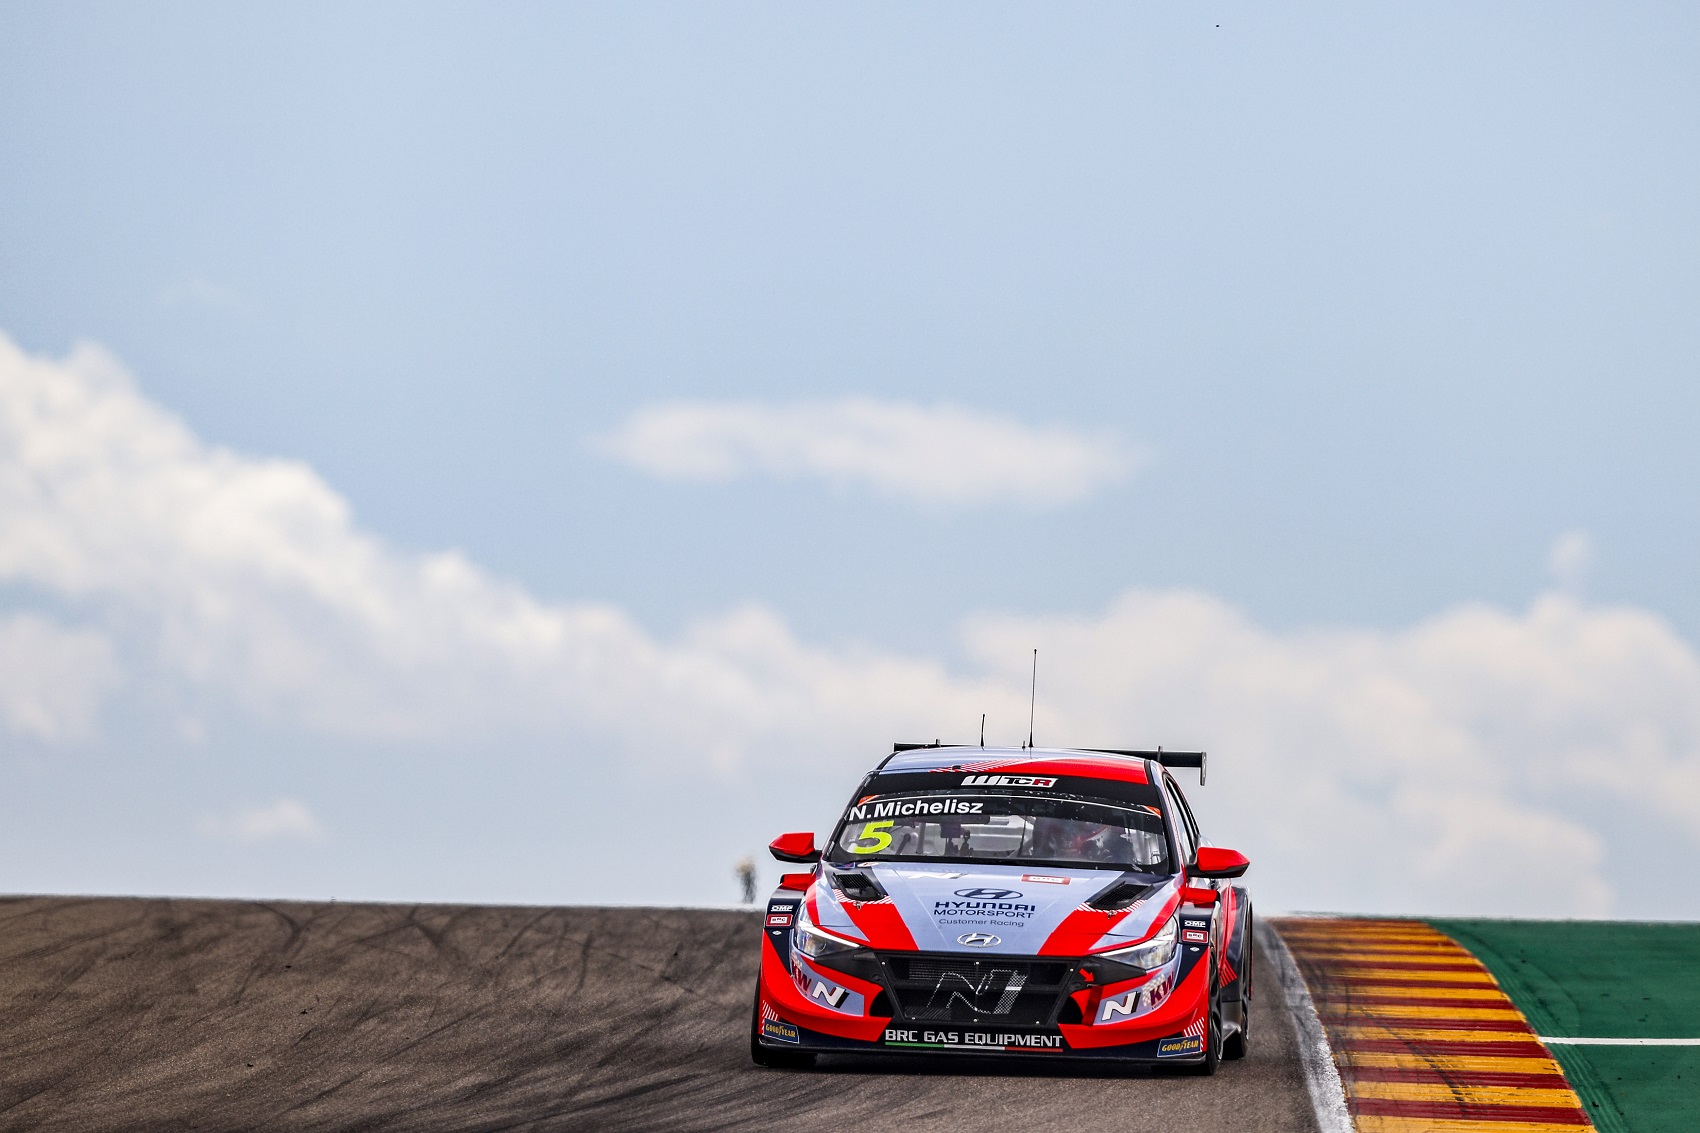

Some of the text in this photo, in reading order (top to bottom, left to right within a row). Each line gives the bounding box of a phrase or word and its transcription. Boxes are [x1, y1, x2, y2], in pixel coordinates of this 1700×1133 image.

[961, 775, 1058, 787] WTCR
[849, 799, 984, 821] N.Michelisz
[853, 820, 895, 855] 5
[935, 901, 1036, 912] HYUNDAI
[934, 909, 1035, 919] MOTORSPORT
[939, 918, 1025, 928] Customer Racing
[765, 1022, 796, 1038] GOODYEAR
[885, 1029, 1063, 1047] BRC GAS EQUIPMENT
[1161, 1039, 1199, 1052] GOODYEAR
